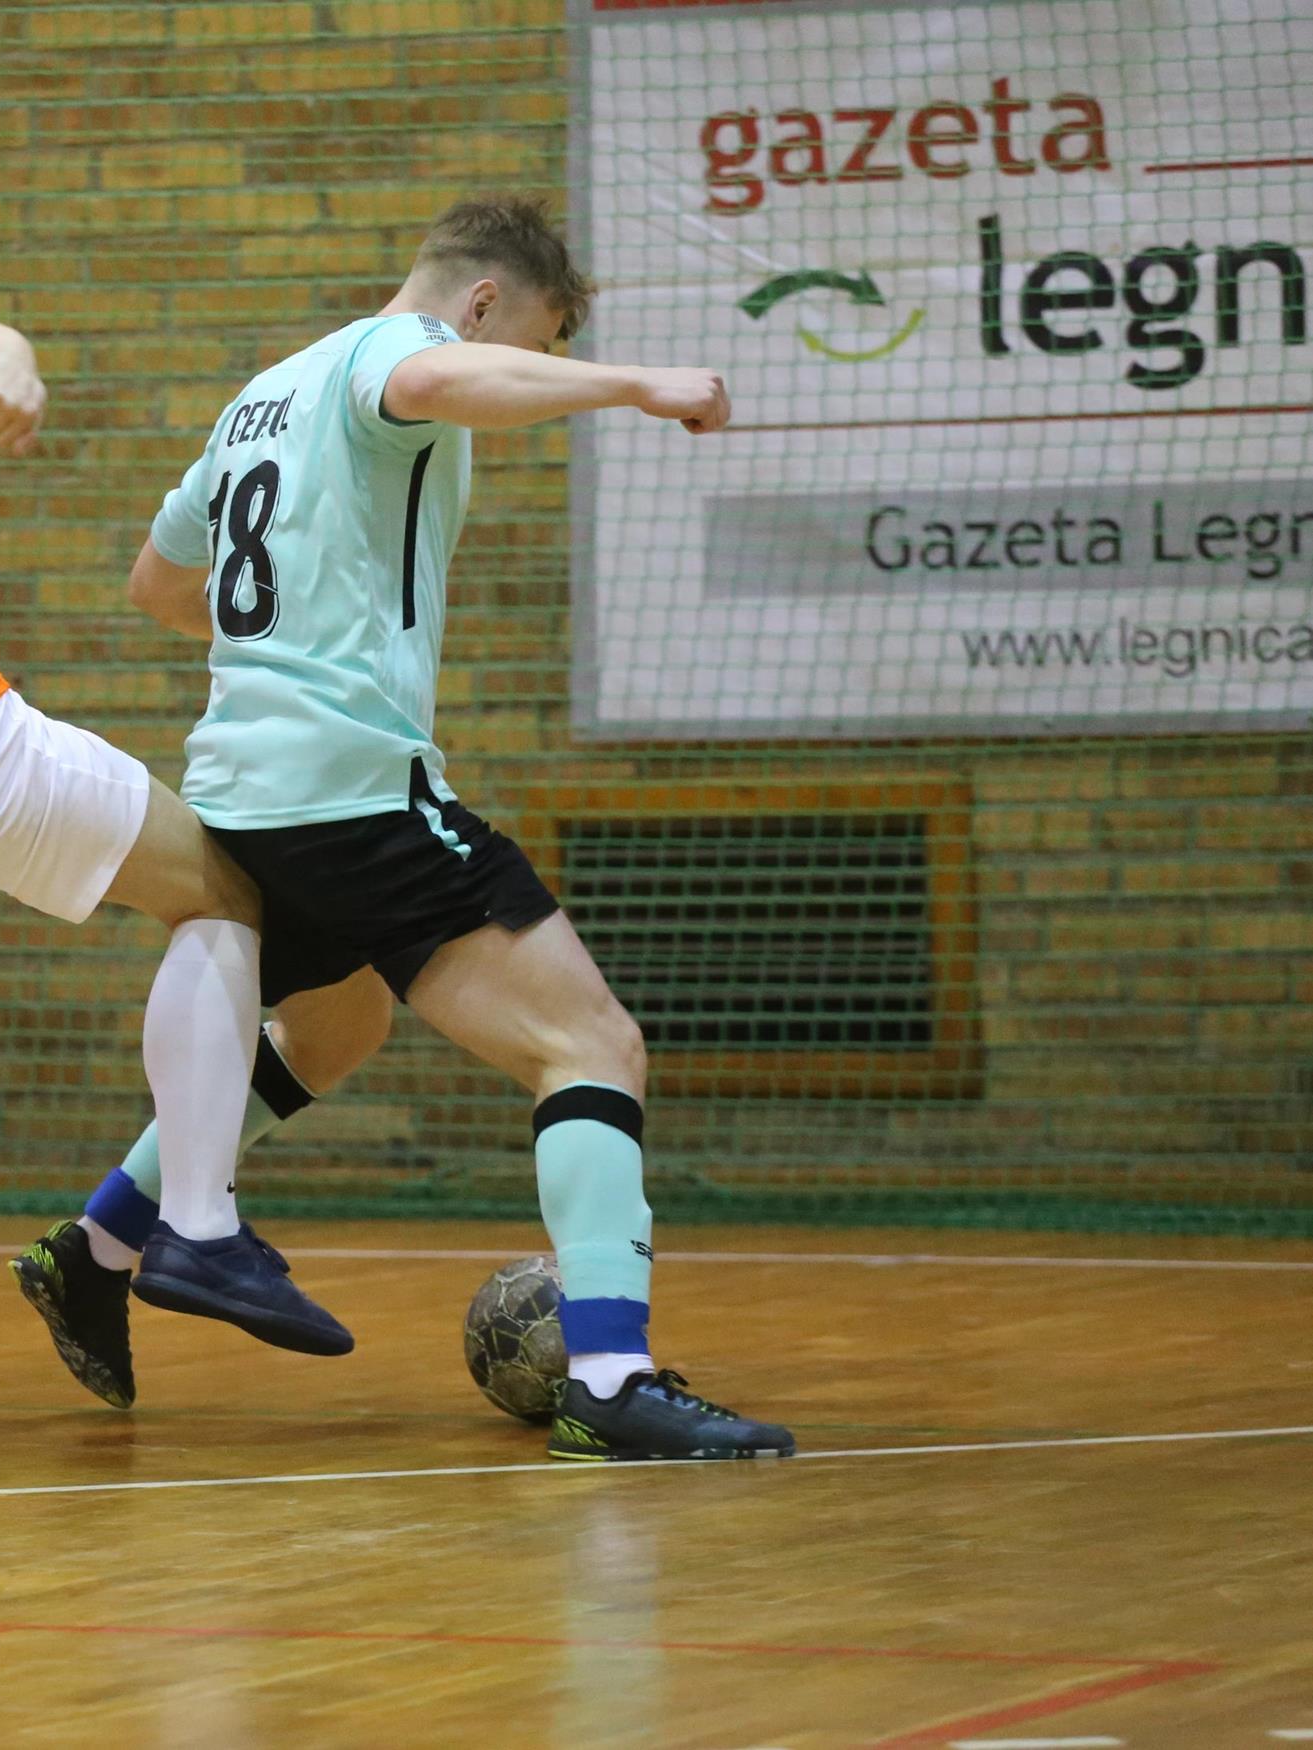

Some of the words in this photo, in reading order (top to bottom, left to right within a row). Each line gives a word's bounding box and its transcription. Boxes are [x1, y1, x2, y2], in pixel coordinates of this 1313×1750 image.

[699, 76, 1112, 217] gazeta
[977, 213, 1308, 390] legn
[205, 459, 282, 643] 18
[865, 503, 1122, 573] Gazeta
[961, 616, 1313, 679] www.legnica
